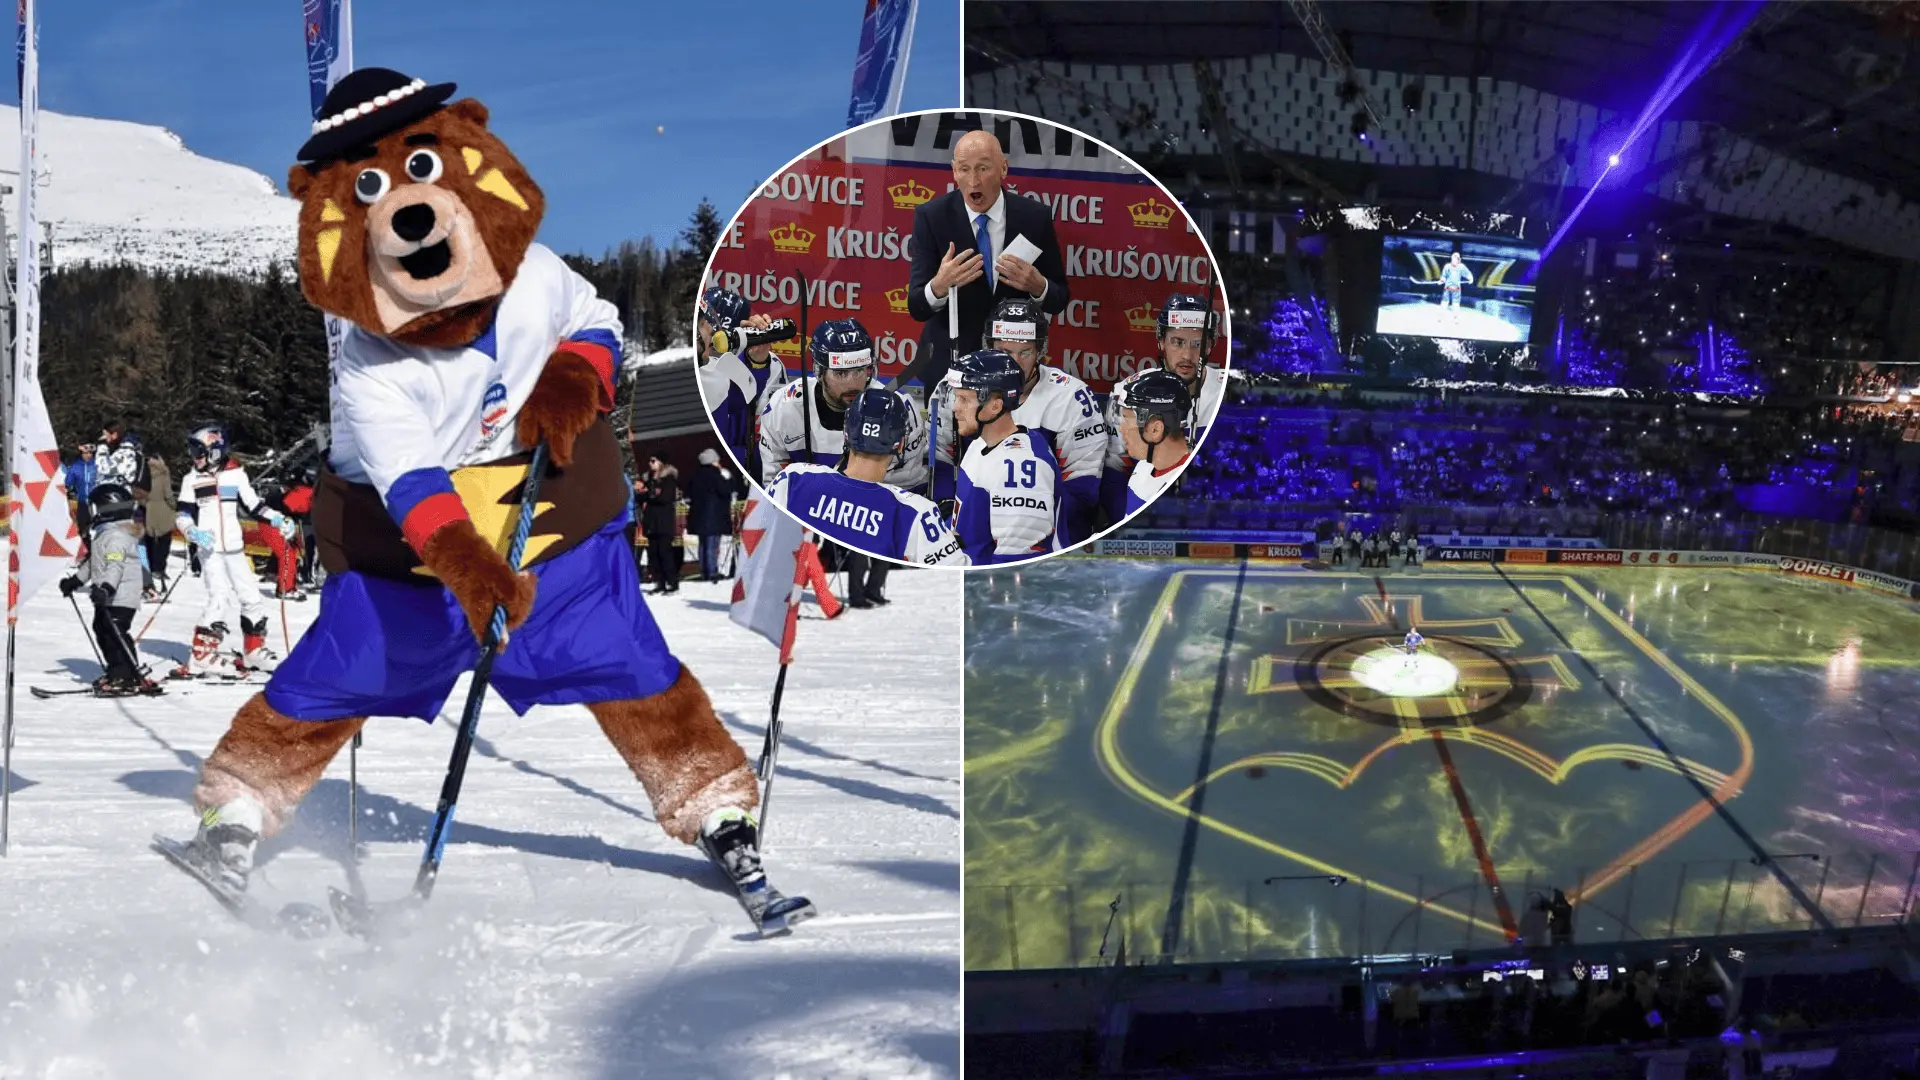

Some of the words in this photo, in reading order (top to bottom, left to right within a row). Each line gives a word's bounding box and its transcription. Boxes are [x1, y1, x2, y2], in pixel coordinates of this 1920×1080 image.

[1007, 307, 1025, 316] 33
[840, 331, 858, 344] 17
[1005, 328, 1035, 336] Kaufland
[861, 422, 881, 438] 62
[1003, 458, 1036, 489] 19
[991, 494, 1048, 512] ŠKODA
[808, 494, 884, 537] JAROS
[1561, 551, 1621, 562] SHATE-M.RU
[1780, 558, 1851, 580] ФОНБЕТ
